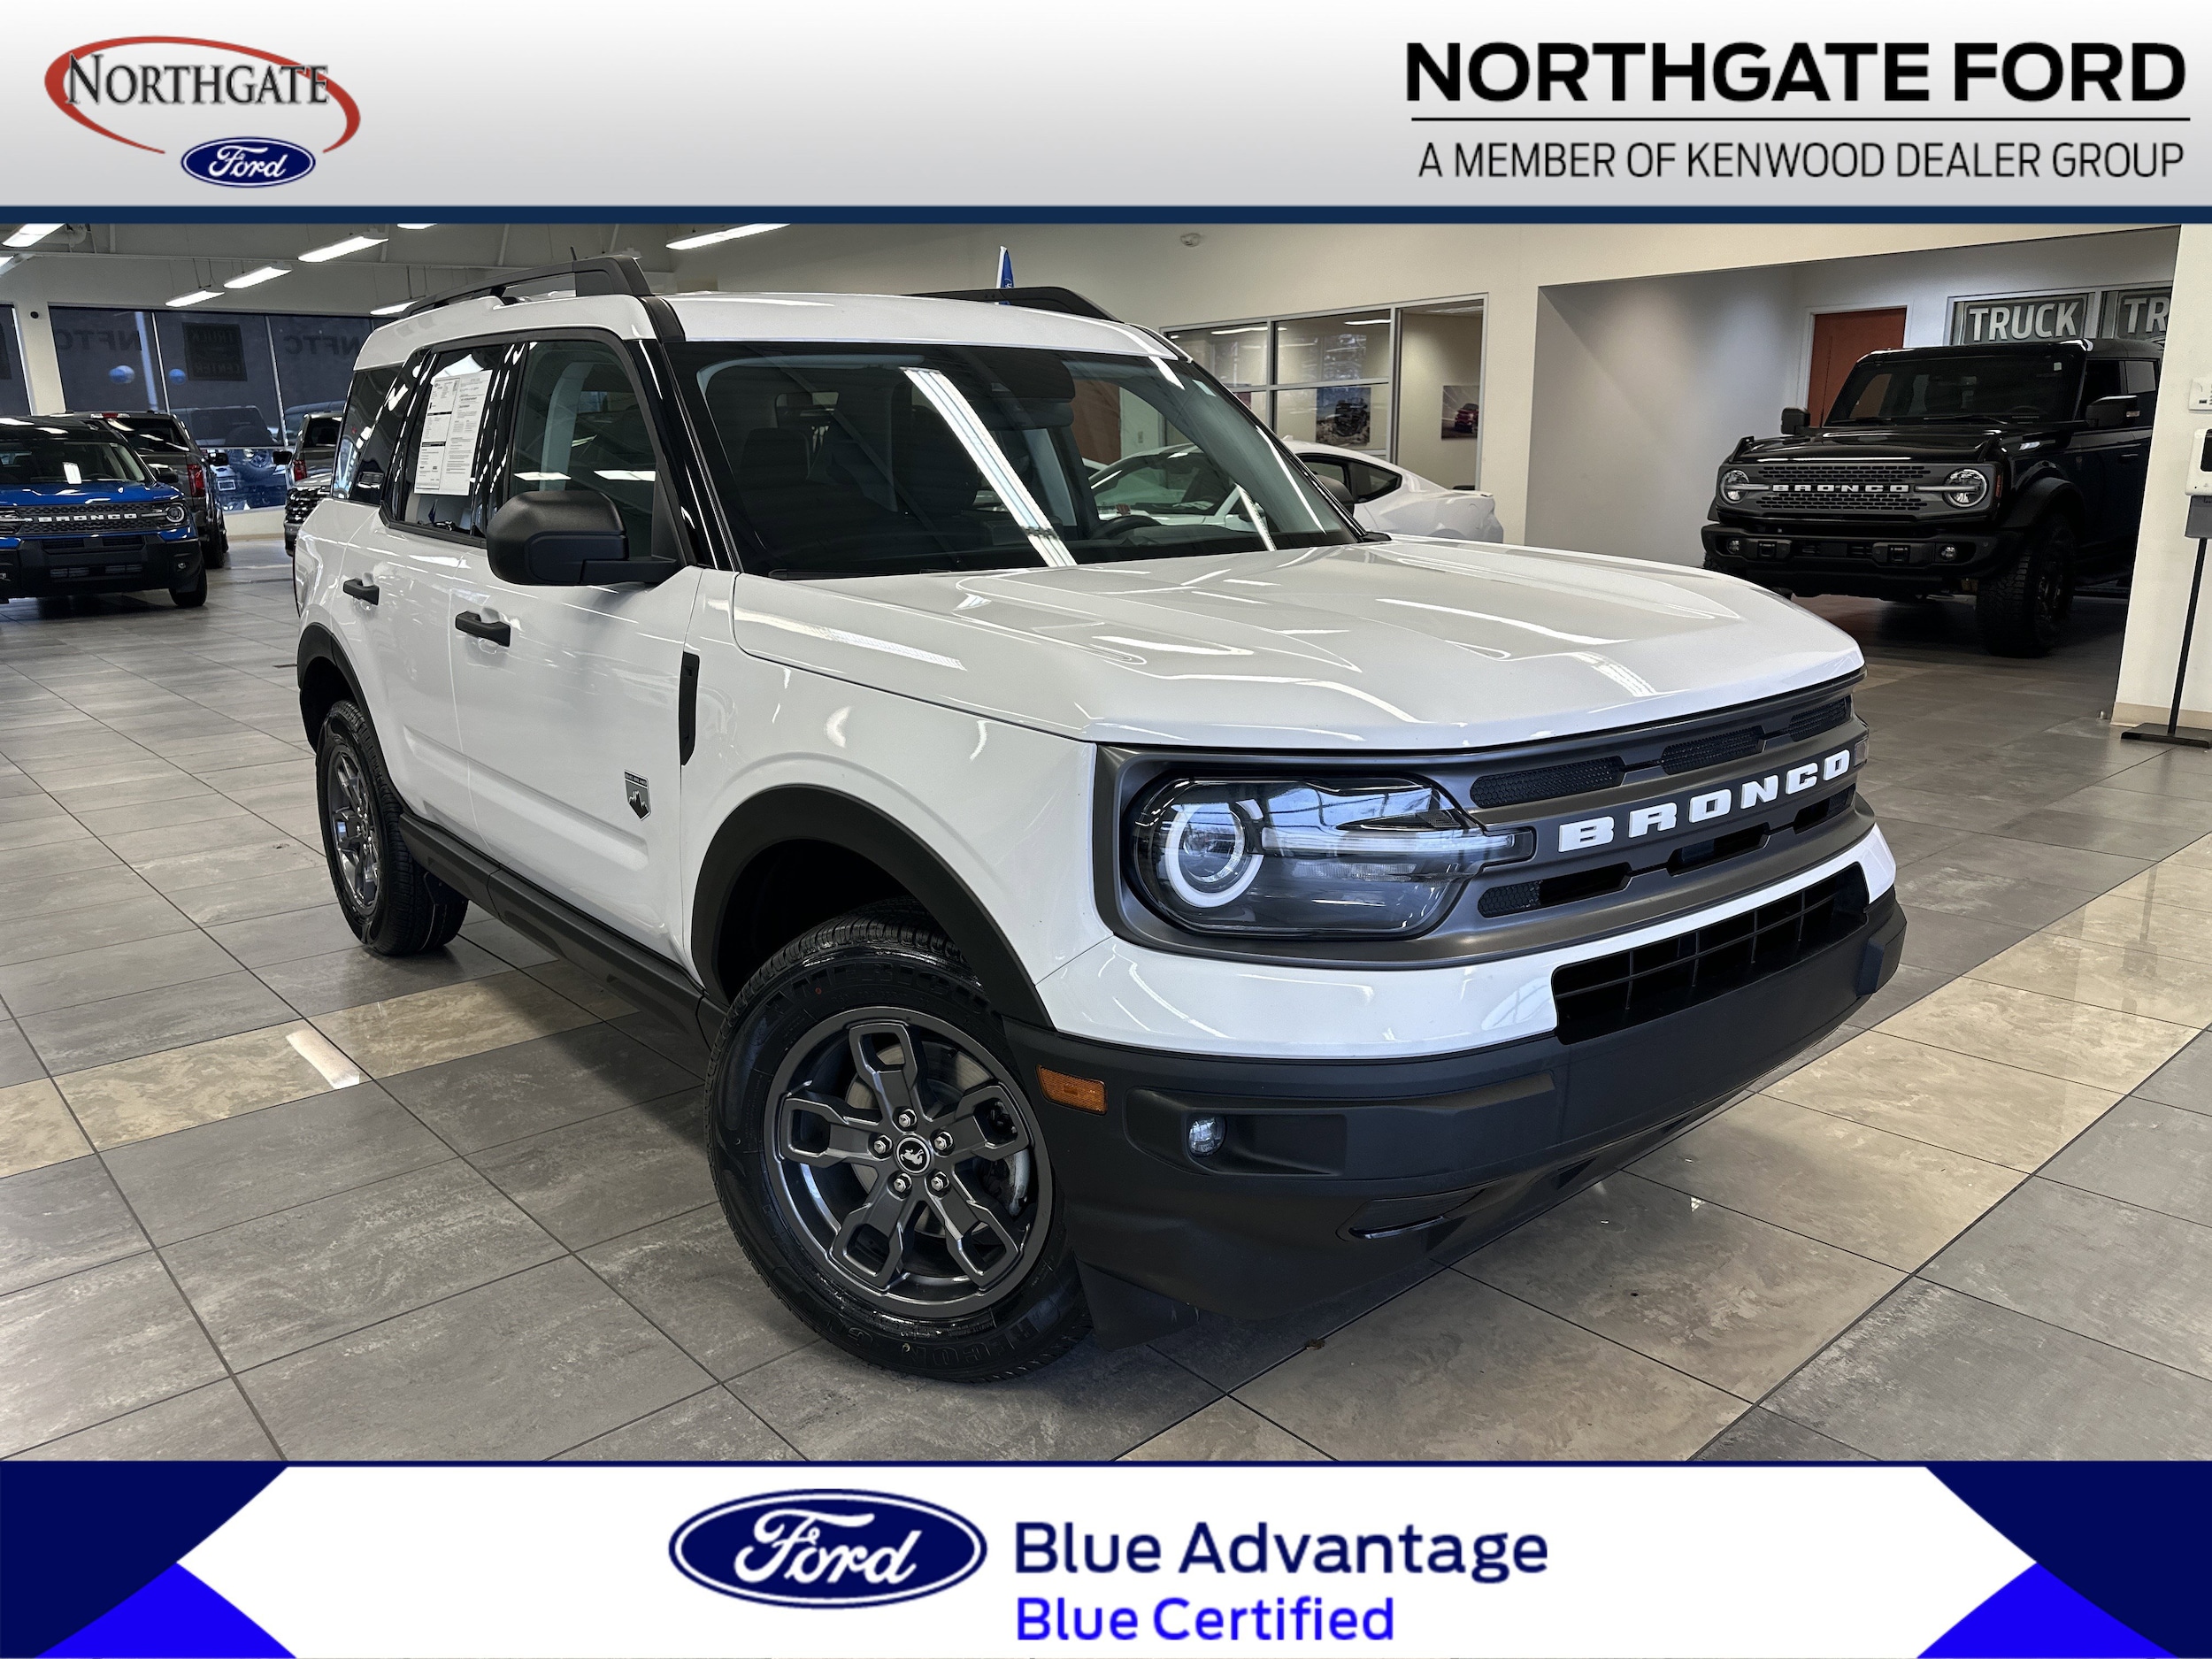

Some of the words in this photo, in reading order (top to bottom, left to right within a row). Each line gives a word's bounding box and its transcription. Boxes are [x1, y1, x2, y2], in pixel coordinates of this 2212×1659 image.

[1970, 301, 2079, 342] TRUCK
[1772, 483, 1909, 494] BRONCO
[38, 512, 137, 523] BRONCO
[1558, 749, 1851, 854] BRONCO
